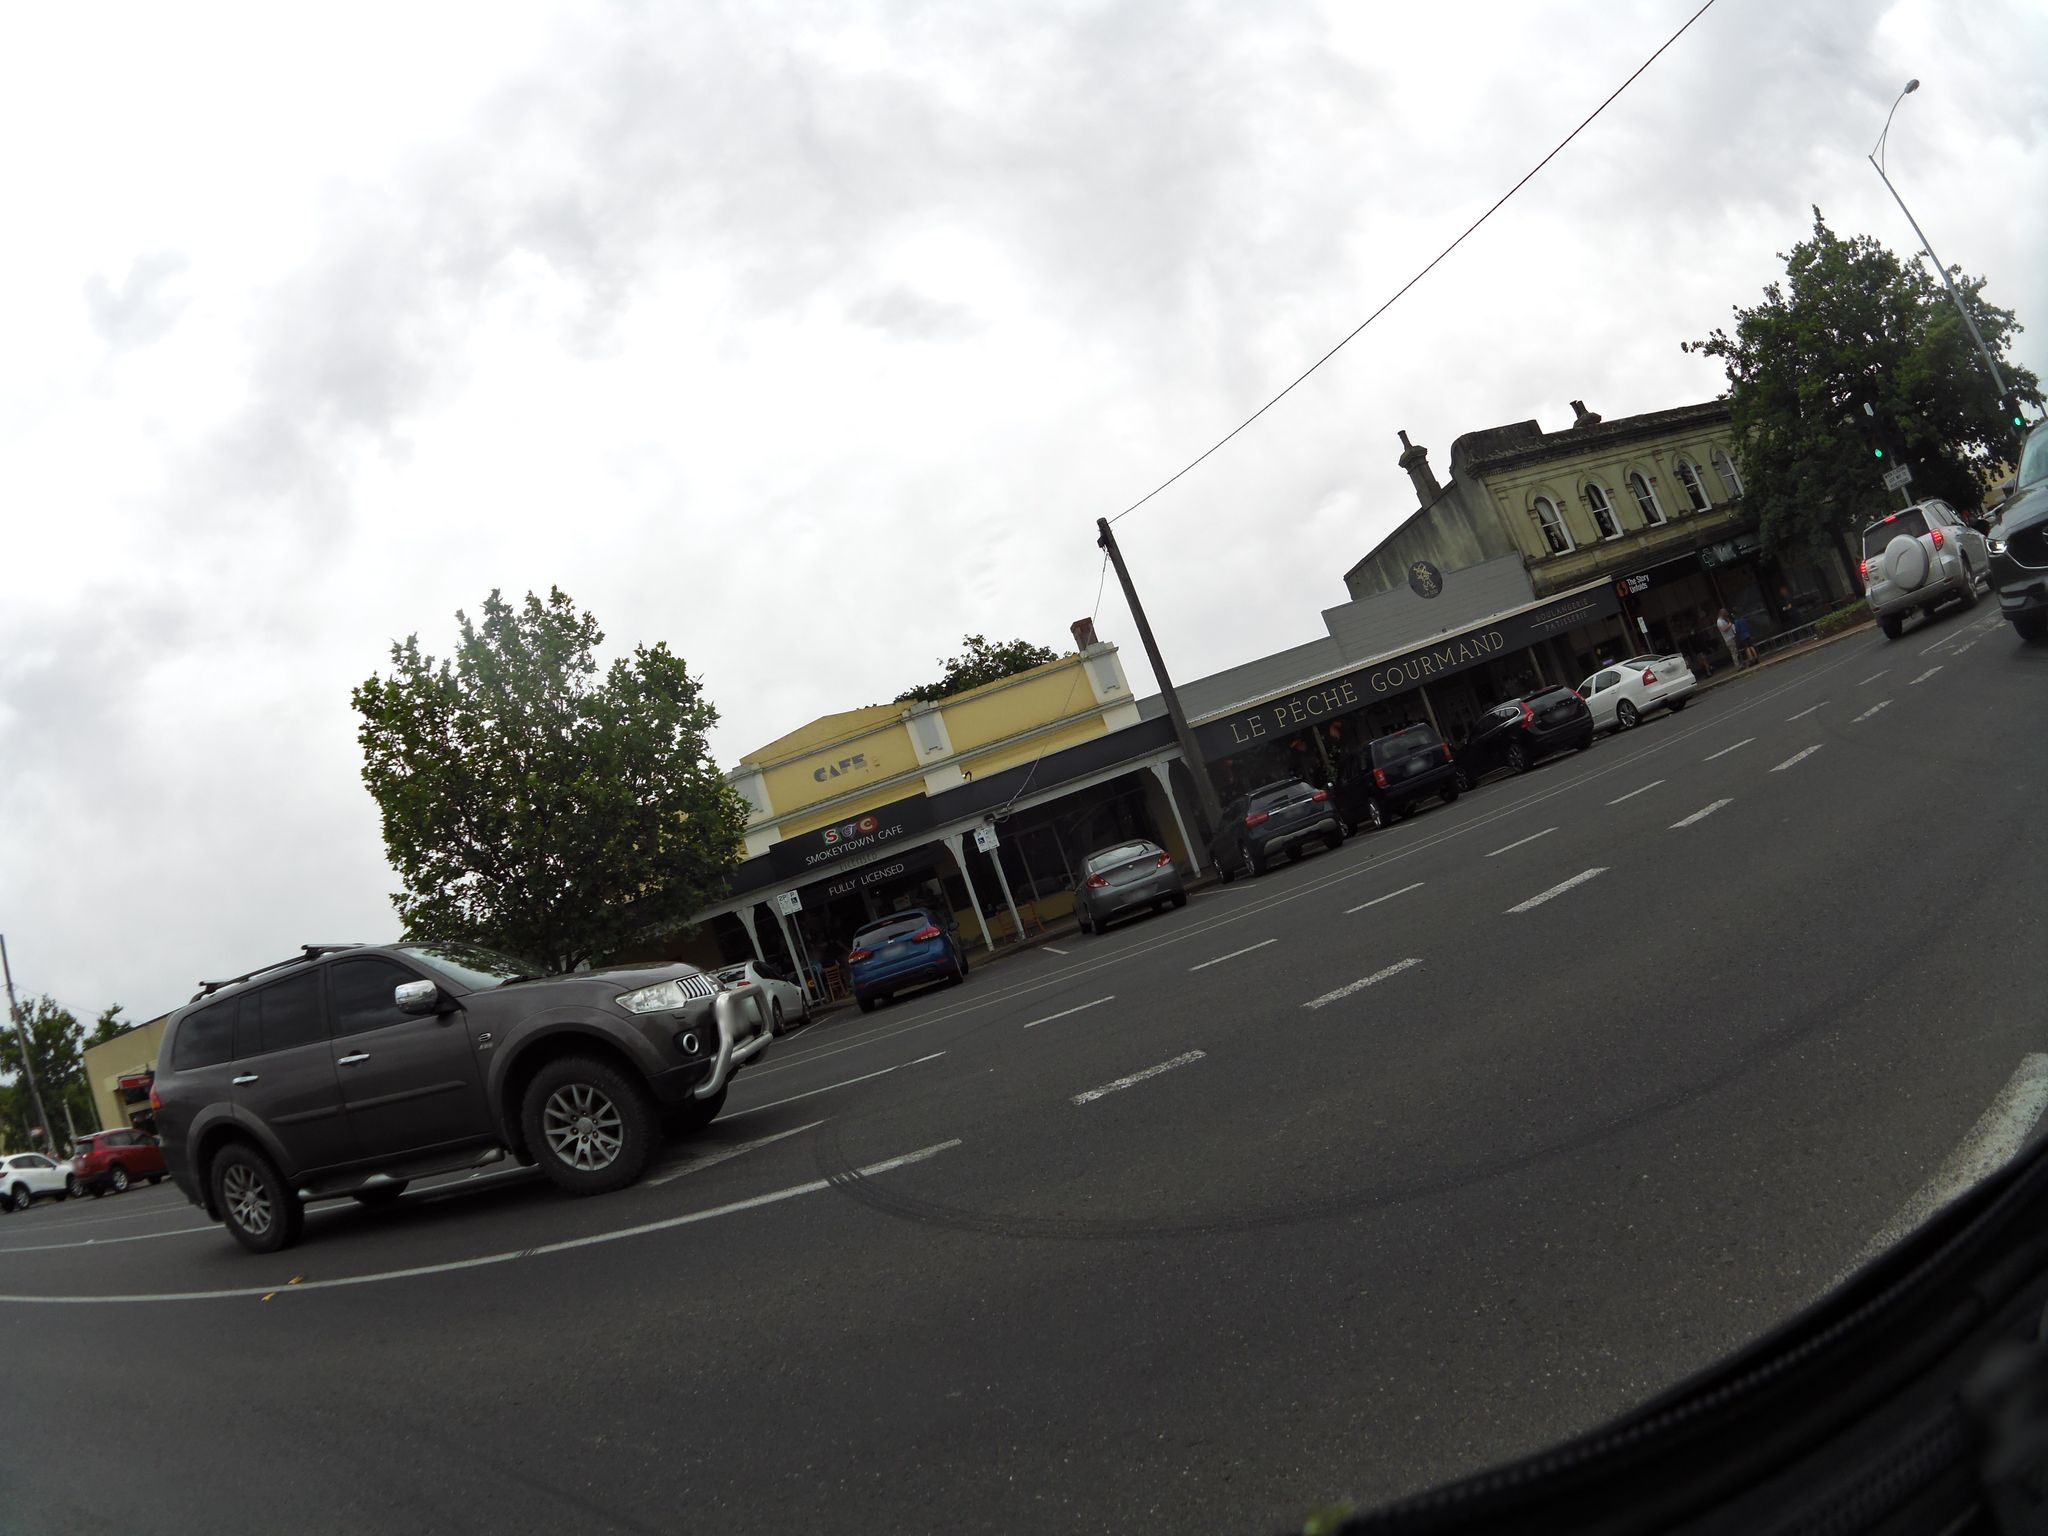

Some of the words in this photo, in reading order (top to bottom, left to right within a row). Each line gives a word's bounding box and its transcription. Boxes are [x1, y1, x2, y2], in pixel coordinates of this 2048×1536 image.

[1626, 578, 1637, 586] The
[1636, 574, 1650, 583] Story
[1629, 582, 1648, 593] Unfolds
[1230, 715, 1266, 744] LE
[1273, 680, 1358, 728] PÉCHÉ
[1371, 631, 1504, 692] GOURMAND
[813, 753, 868, 783] CAFE
[805, 834, 875, 866] SMOKEYTOWN
[877, 824, 904, 840] CAFE
[828, 879, 857, 896] FULLY
[860, 863, 904, 885] LICENSED
